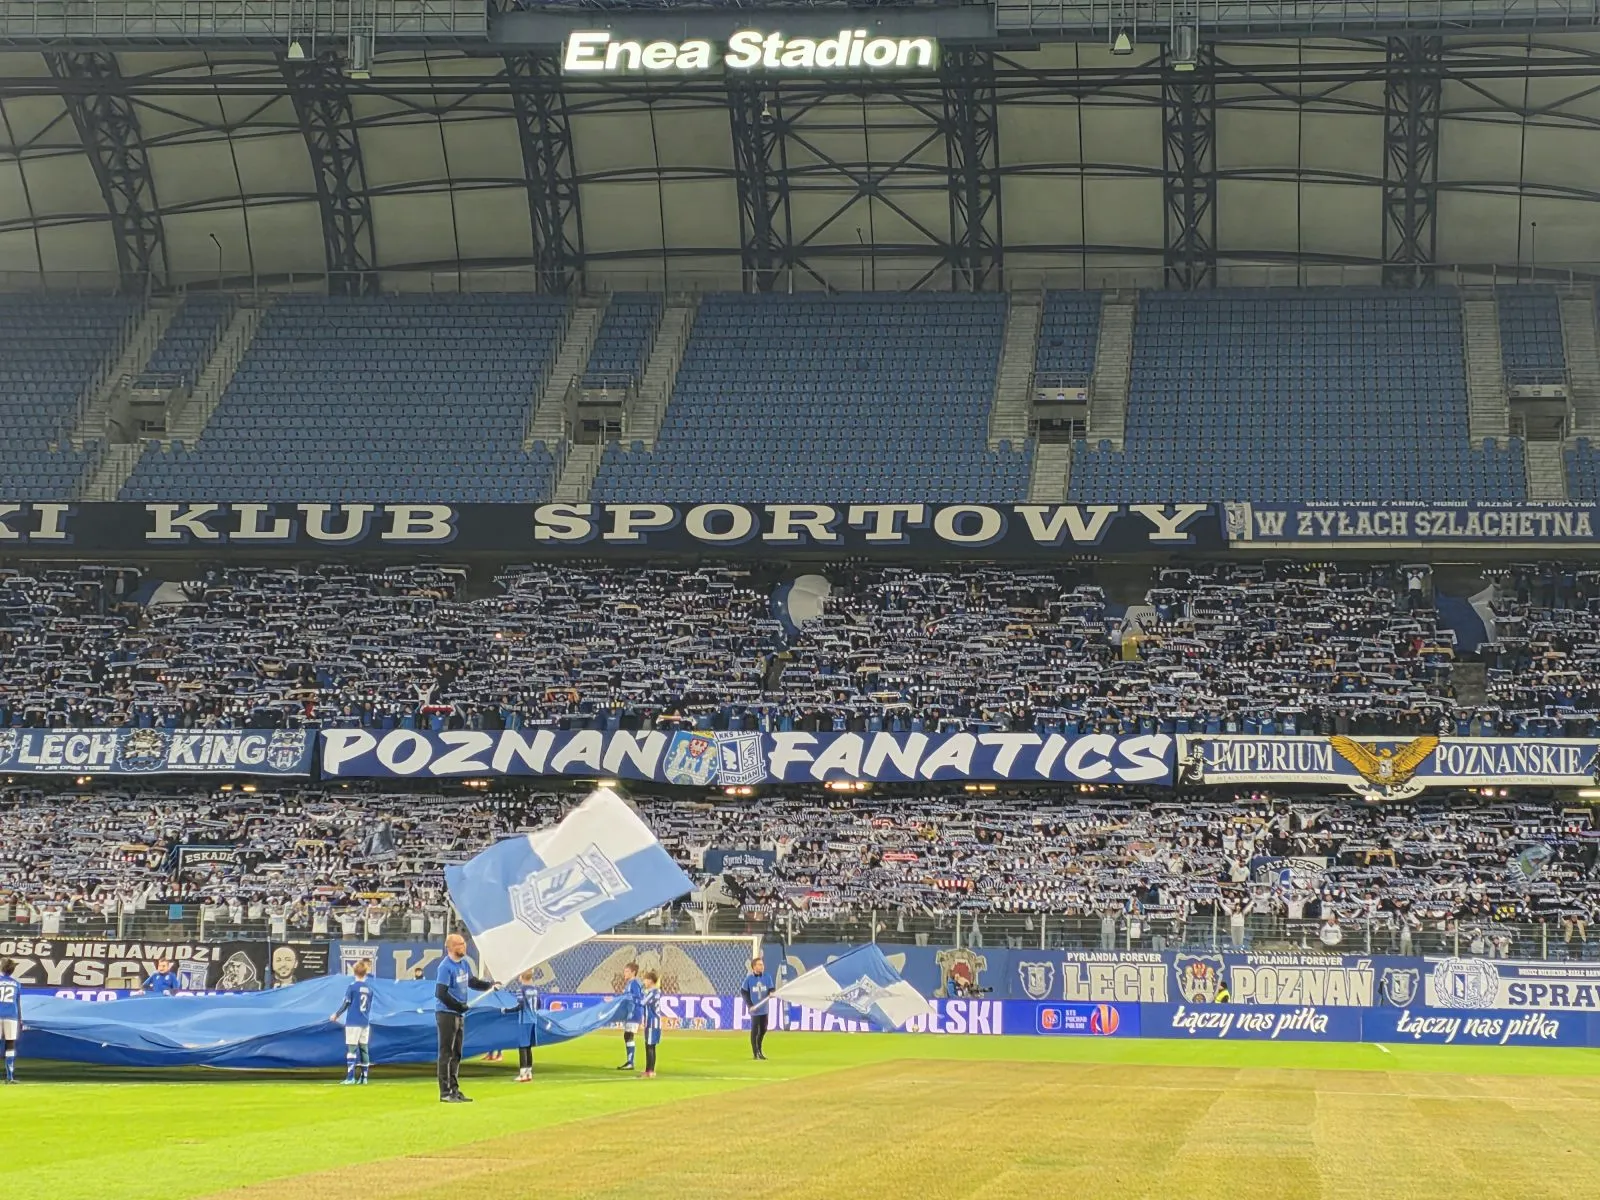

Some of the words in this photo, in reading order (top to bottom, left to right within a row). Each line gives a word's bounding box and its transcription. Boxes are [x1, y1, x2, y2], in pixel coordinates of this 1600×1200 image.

[564, 31, 710, 72] Enea
[724, 29, 934, 70] Stadion
[0, 503, 69, 540] I
[145, 503, 453, 541] KLUB
[534, 502, 1208, 542] SPORTOWY
[1254, 511, 1287, 536] W
[1414, 511, 1594, 537] SZLACHETNA
[18, 734, 118, 765] LECH
[167, 734, 267, 765] KING
[768, 731, 1173, 782] FANATICS
[1211, 741, 1336, 773] IMPERIUM
[1433, 743, 1586, 775] POZNAŃSKIE
[65, 943, 221, 962] NIENAWIDZI
[1067, 952, 1119, 962] PYRLANDIA
[1119, 953, 1162, 962] FOREVER
[1247, 955, 1299, 965] PYRLANDIA
[1300, 956, 1344, 966] FOREVER
[1062, 962, 1168, 1003] LECH
[1230, 959, 1375, 1007] POZNAŃ
[1508, 982, 1600, 1009] SPRA
[360, 994, 368, 1012] 2
[1171, 1005, 1235, 1038] Łączy
[1235, 1012, 1276, 1031] nas
[1271, 1007, 1329, 1039] piłka
[1396, 1010, 1462, 1044] Łączy
[1463, 1016, 1503, 1038] nas
[1498, 1012, 1560, 1045] piłka
